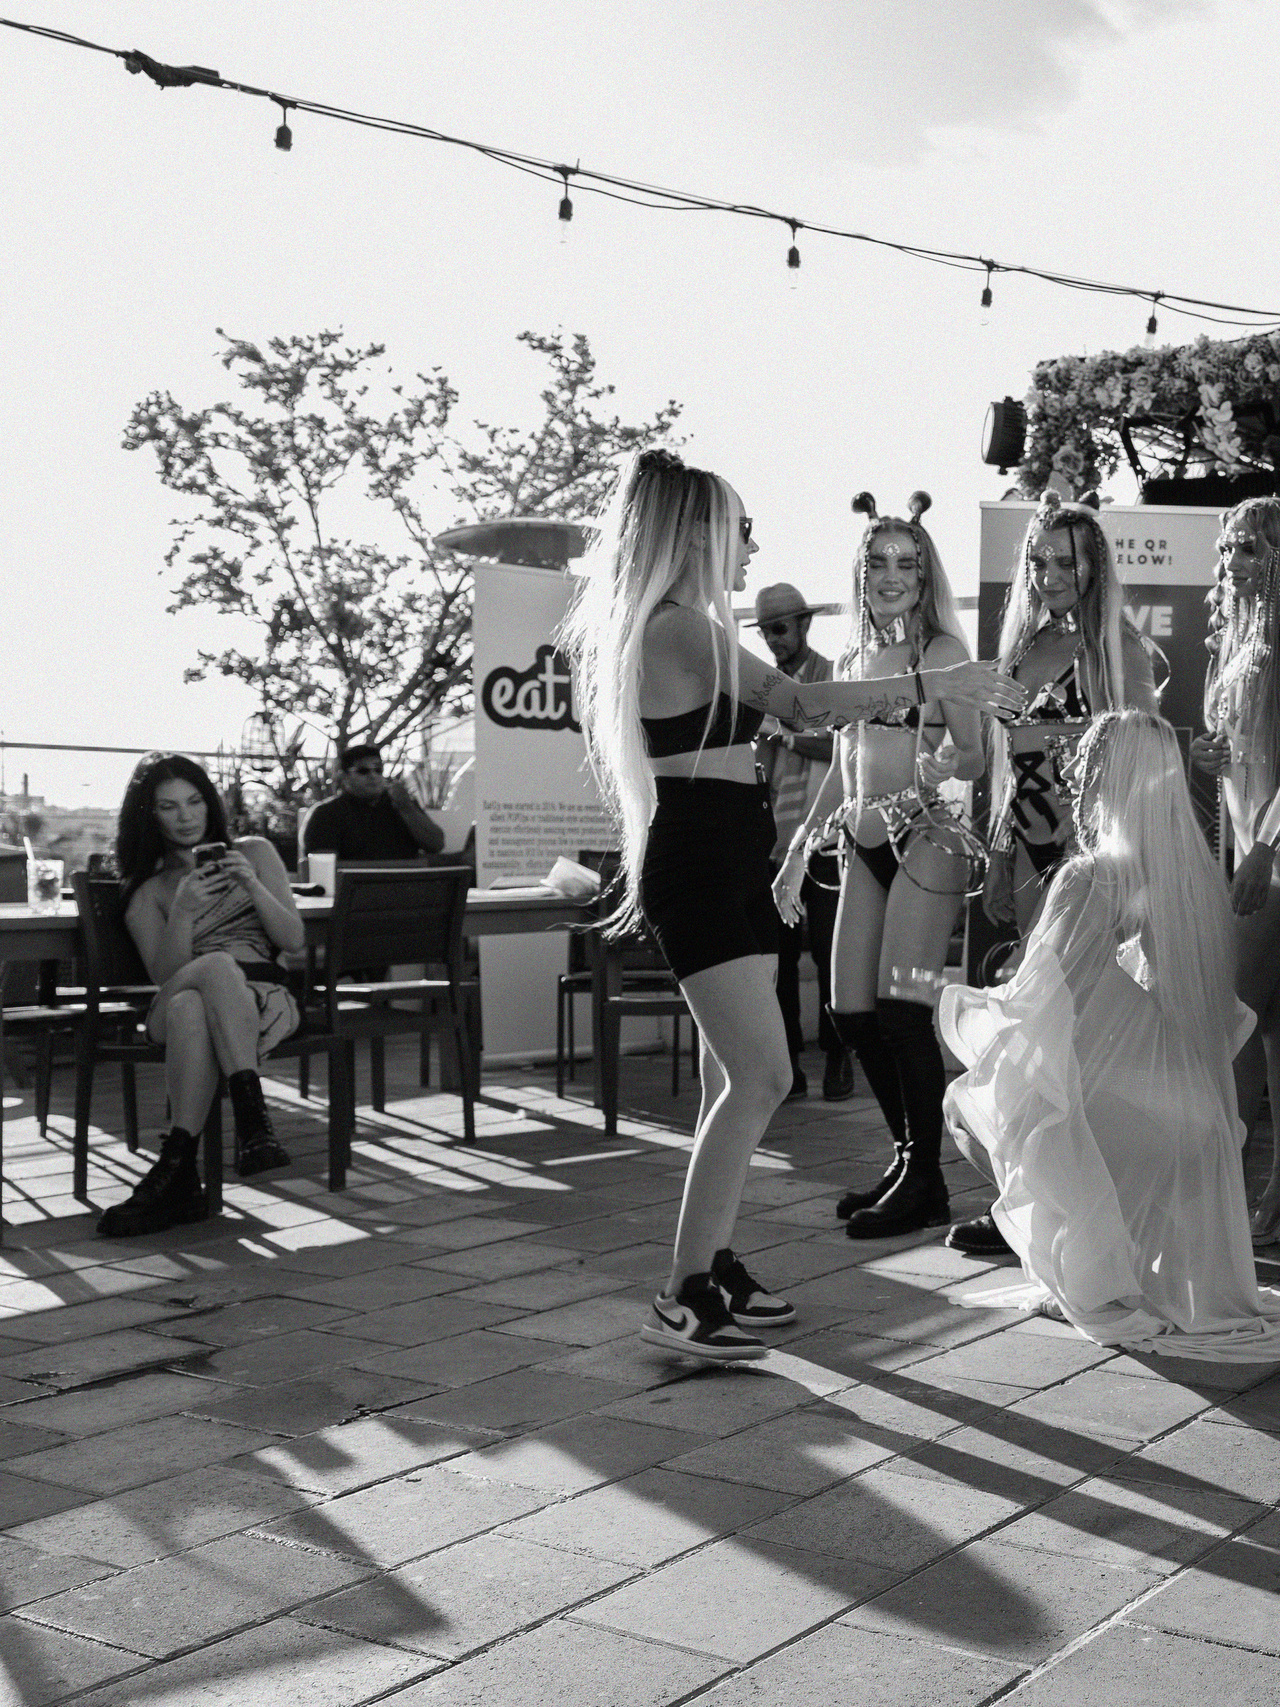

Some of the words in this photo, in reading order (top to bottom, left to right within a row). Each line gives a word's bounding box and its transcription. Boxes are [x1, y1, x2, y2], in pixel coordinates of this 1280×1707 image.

[1115, 539, 1135, 549] HE
[1145, 539, 1167, 552] QR
[1116, 554, 1172, 566] ELOW!
[1122, 605, 1173, 636] VE
